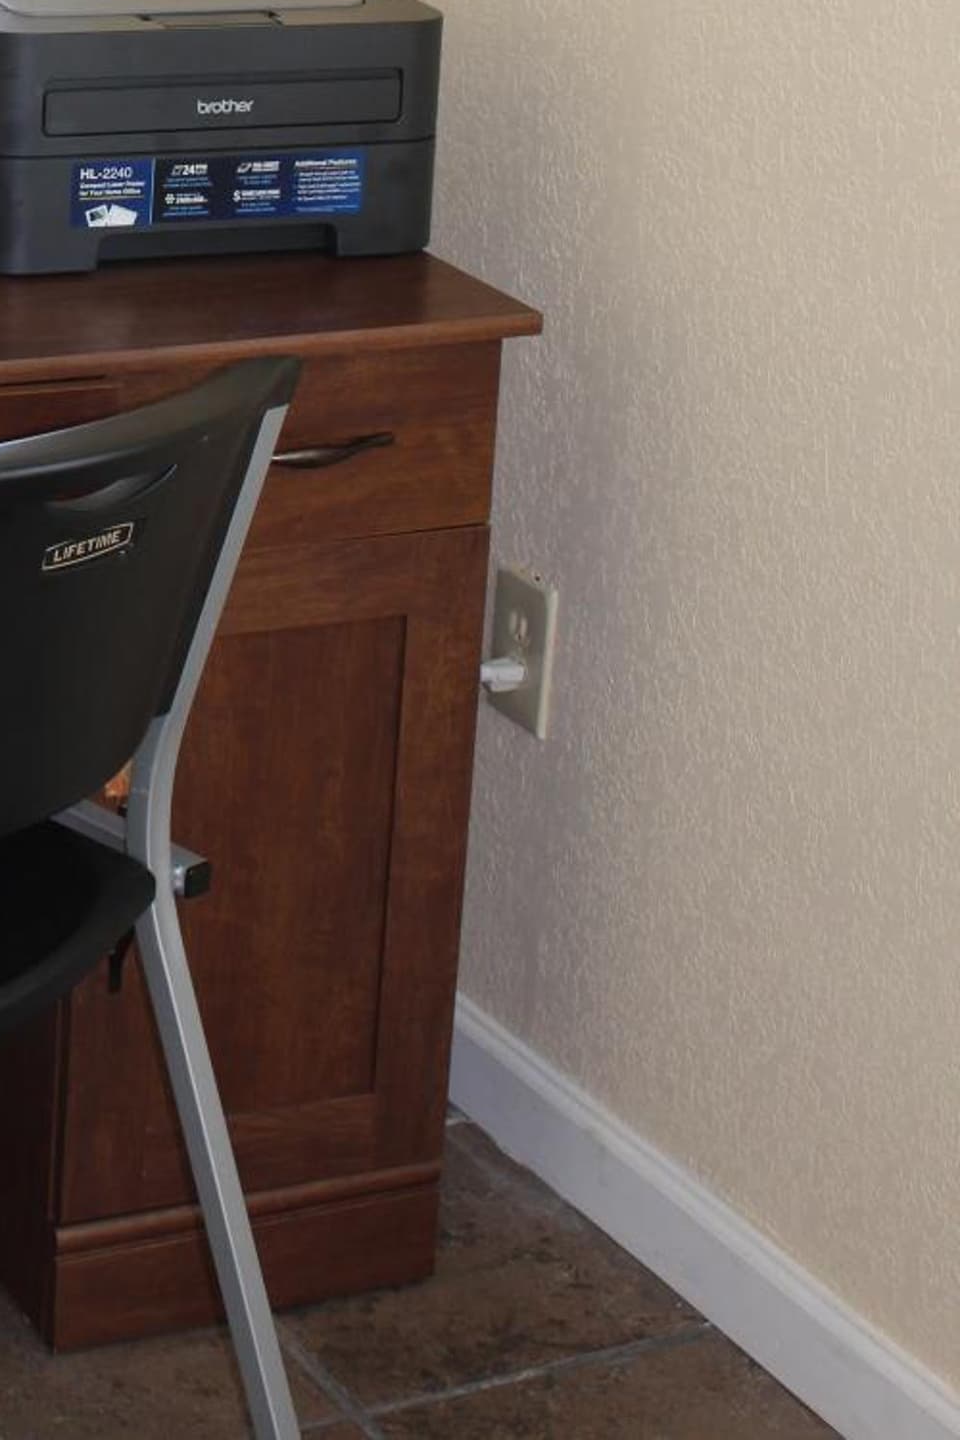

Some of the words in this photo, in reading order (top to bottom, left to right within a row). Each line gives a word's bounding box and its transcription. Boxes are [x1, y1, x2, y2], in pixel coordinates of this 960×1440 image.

[197, 98, 255, 115] brother
[79, 166, 134, 181] HL-2240
[52, 530, 122, 562] LIFETIME
